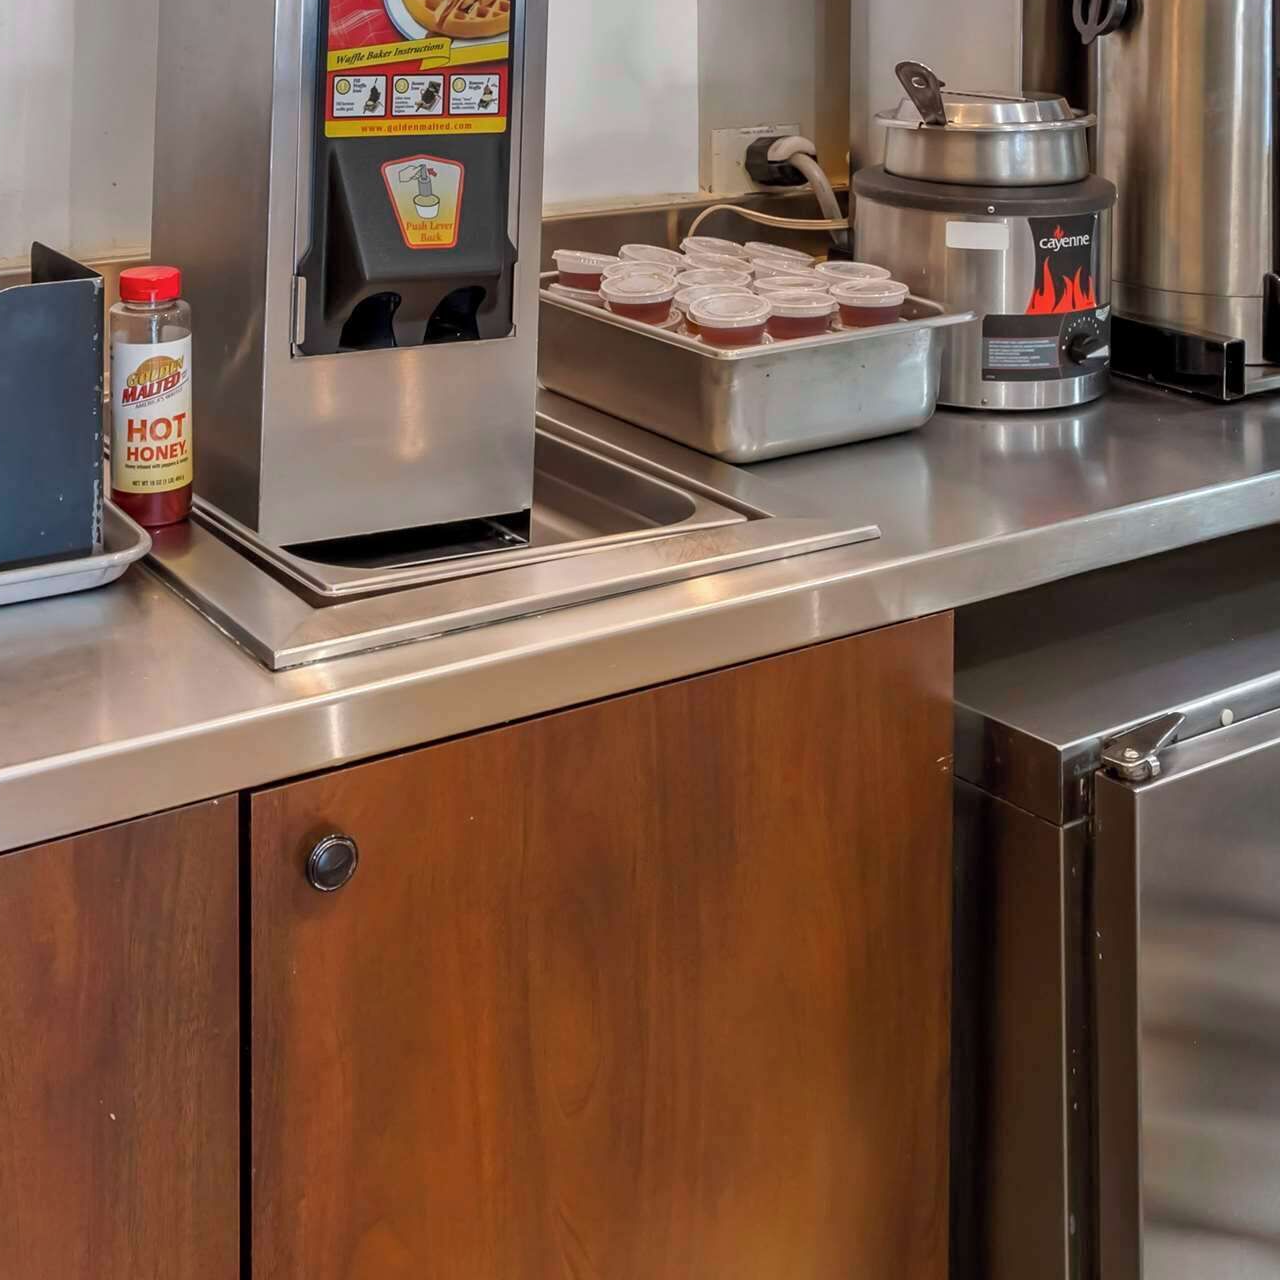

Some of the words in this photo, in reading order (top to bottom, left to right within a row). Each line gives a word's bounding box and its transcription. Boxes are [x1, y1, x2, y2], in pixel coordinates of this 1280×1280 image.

[336, 51, 365, 65] Waffle
[367, 48, 393, 61] Baker
[394, 42, 445, 57] Instructions
[361, 122, 473, 133] www.goldenmalted.com
[1039, 233, 1090, 252] cayenne
[122, 371, 182, 404] MALTED
[127, 412, 186, 443] HOT
